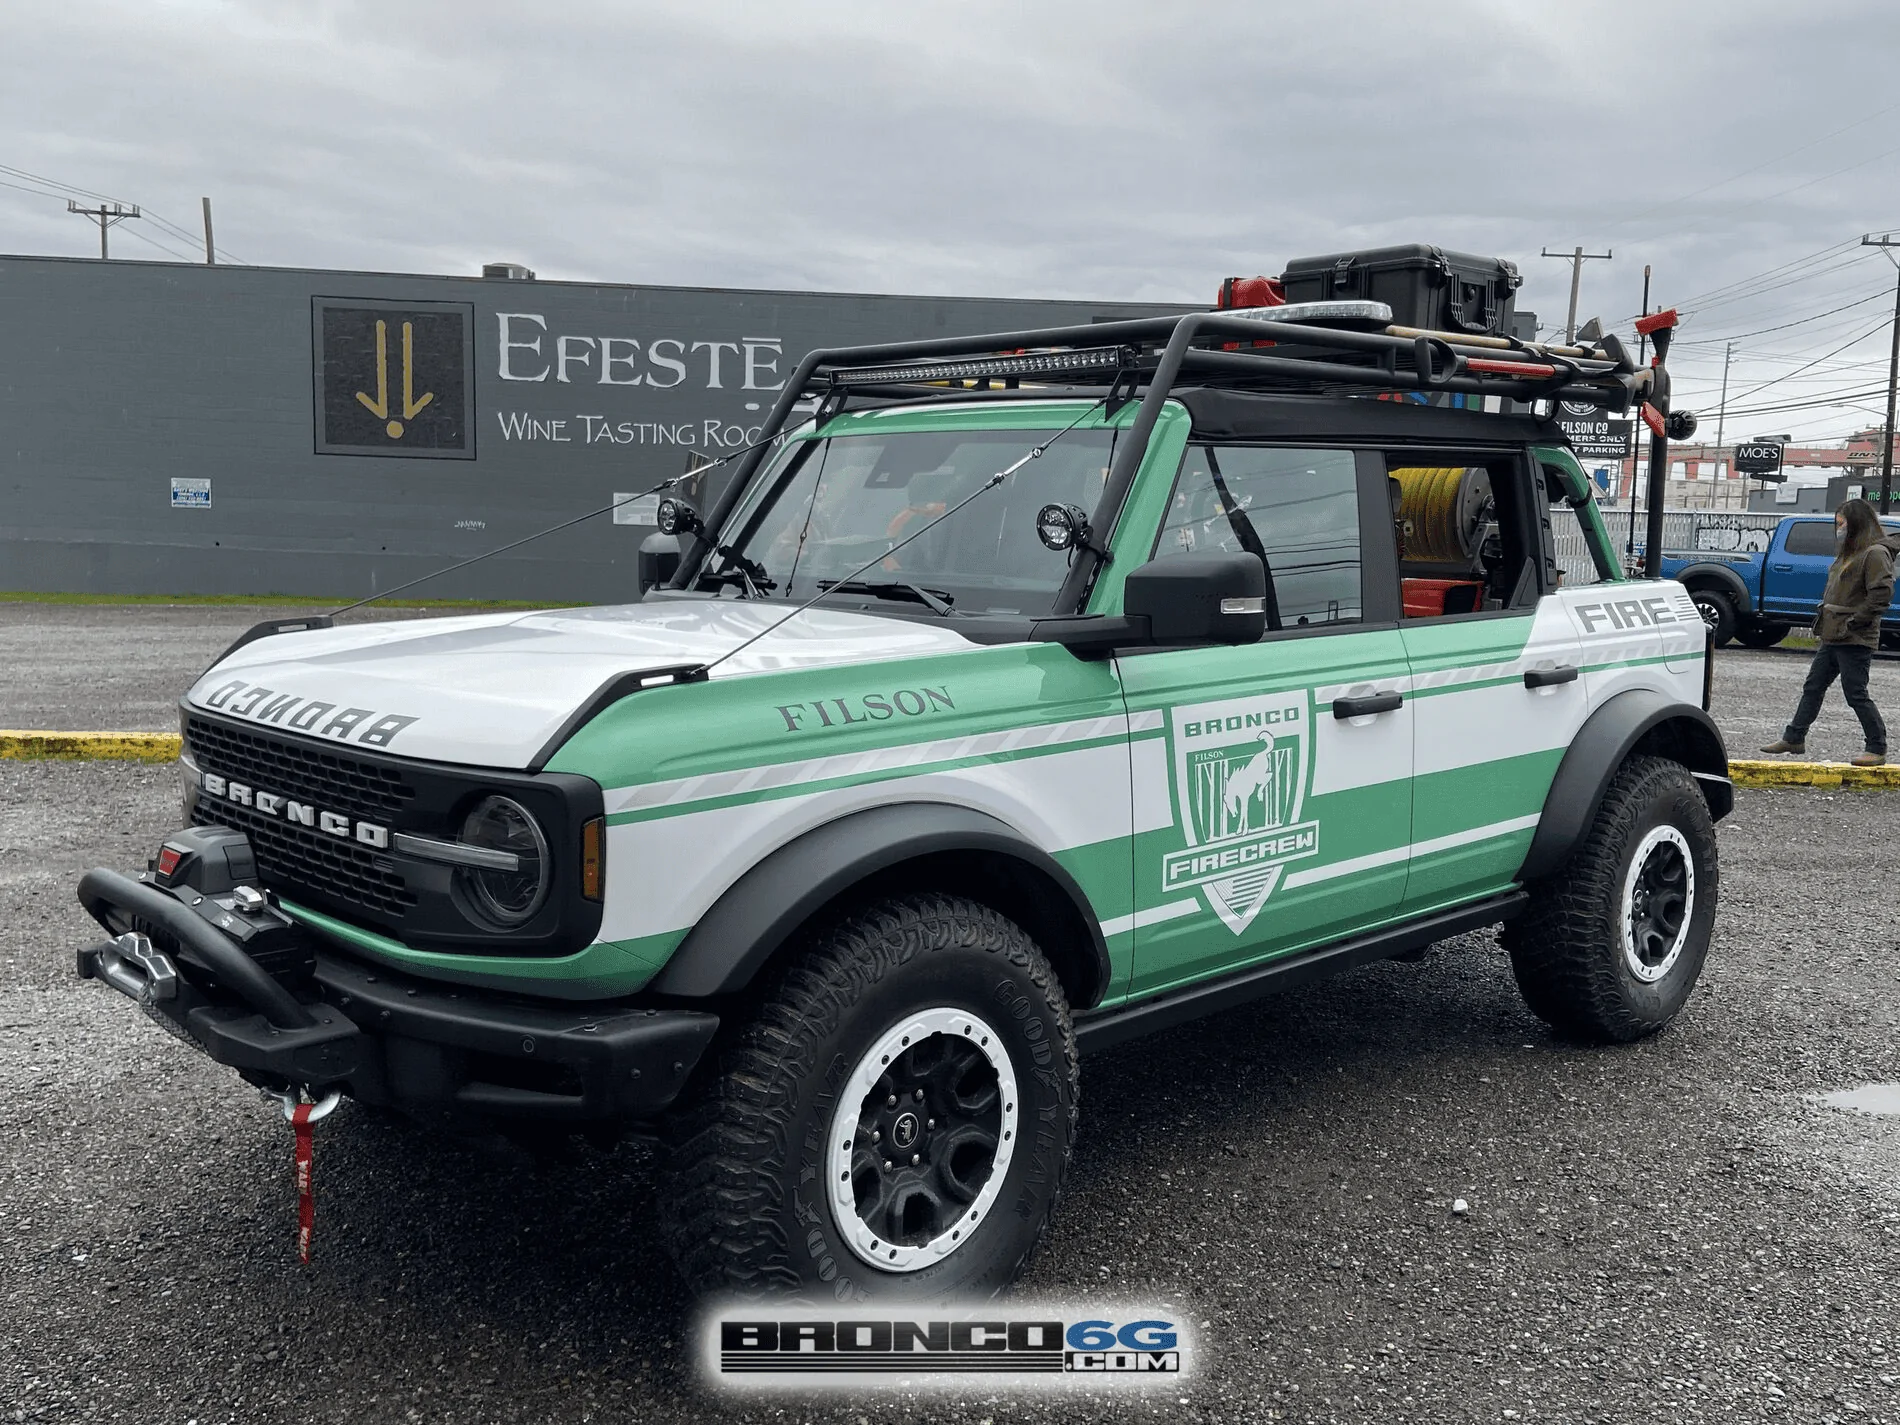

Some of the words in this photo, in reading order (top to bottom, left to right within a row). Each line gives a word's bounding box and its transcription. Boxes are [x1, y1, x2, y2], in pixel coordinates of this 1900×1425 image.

[498, 411, 571, 443] WINE
[576, 414, 696, 446] TASTING
[1561, 421, 1593, 434] FILSON
[1566, 434, 1596, 442] MERS
[1599, 435, 1627, 443] ONLY
[1582, 446, 1626, 454] PARKING
[1739, 447, 1779, 459] MOE'S
[1574, 597, 1677, 633] FIRE
[774, 686, 956, 733] FILSON
[1184, 707, 1300, 738] BRONCO
[1195, 749, 1225, 762] FILSON
[205, 772, 388, 849] BRONCO
[1170, 831, 1315, 880] FIRECREW
